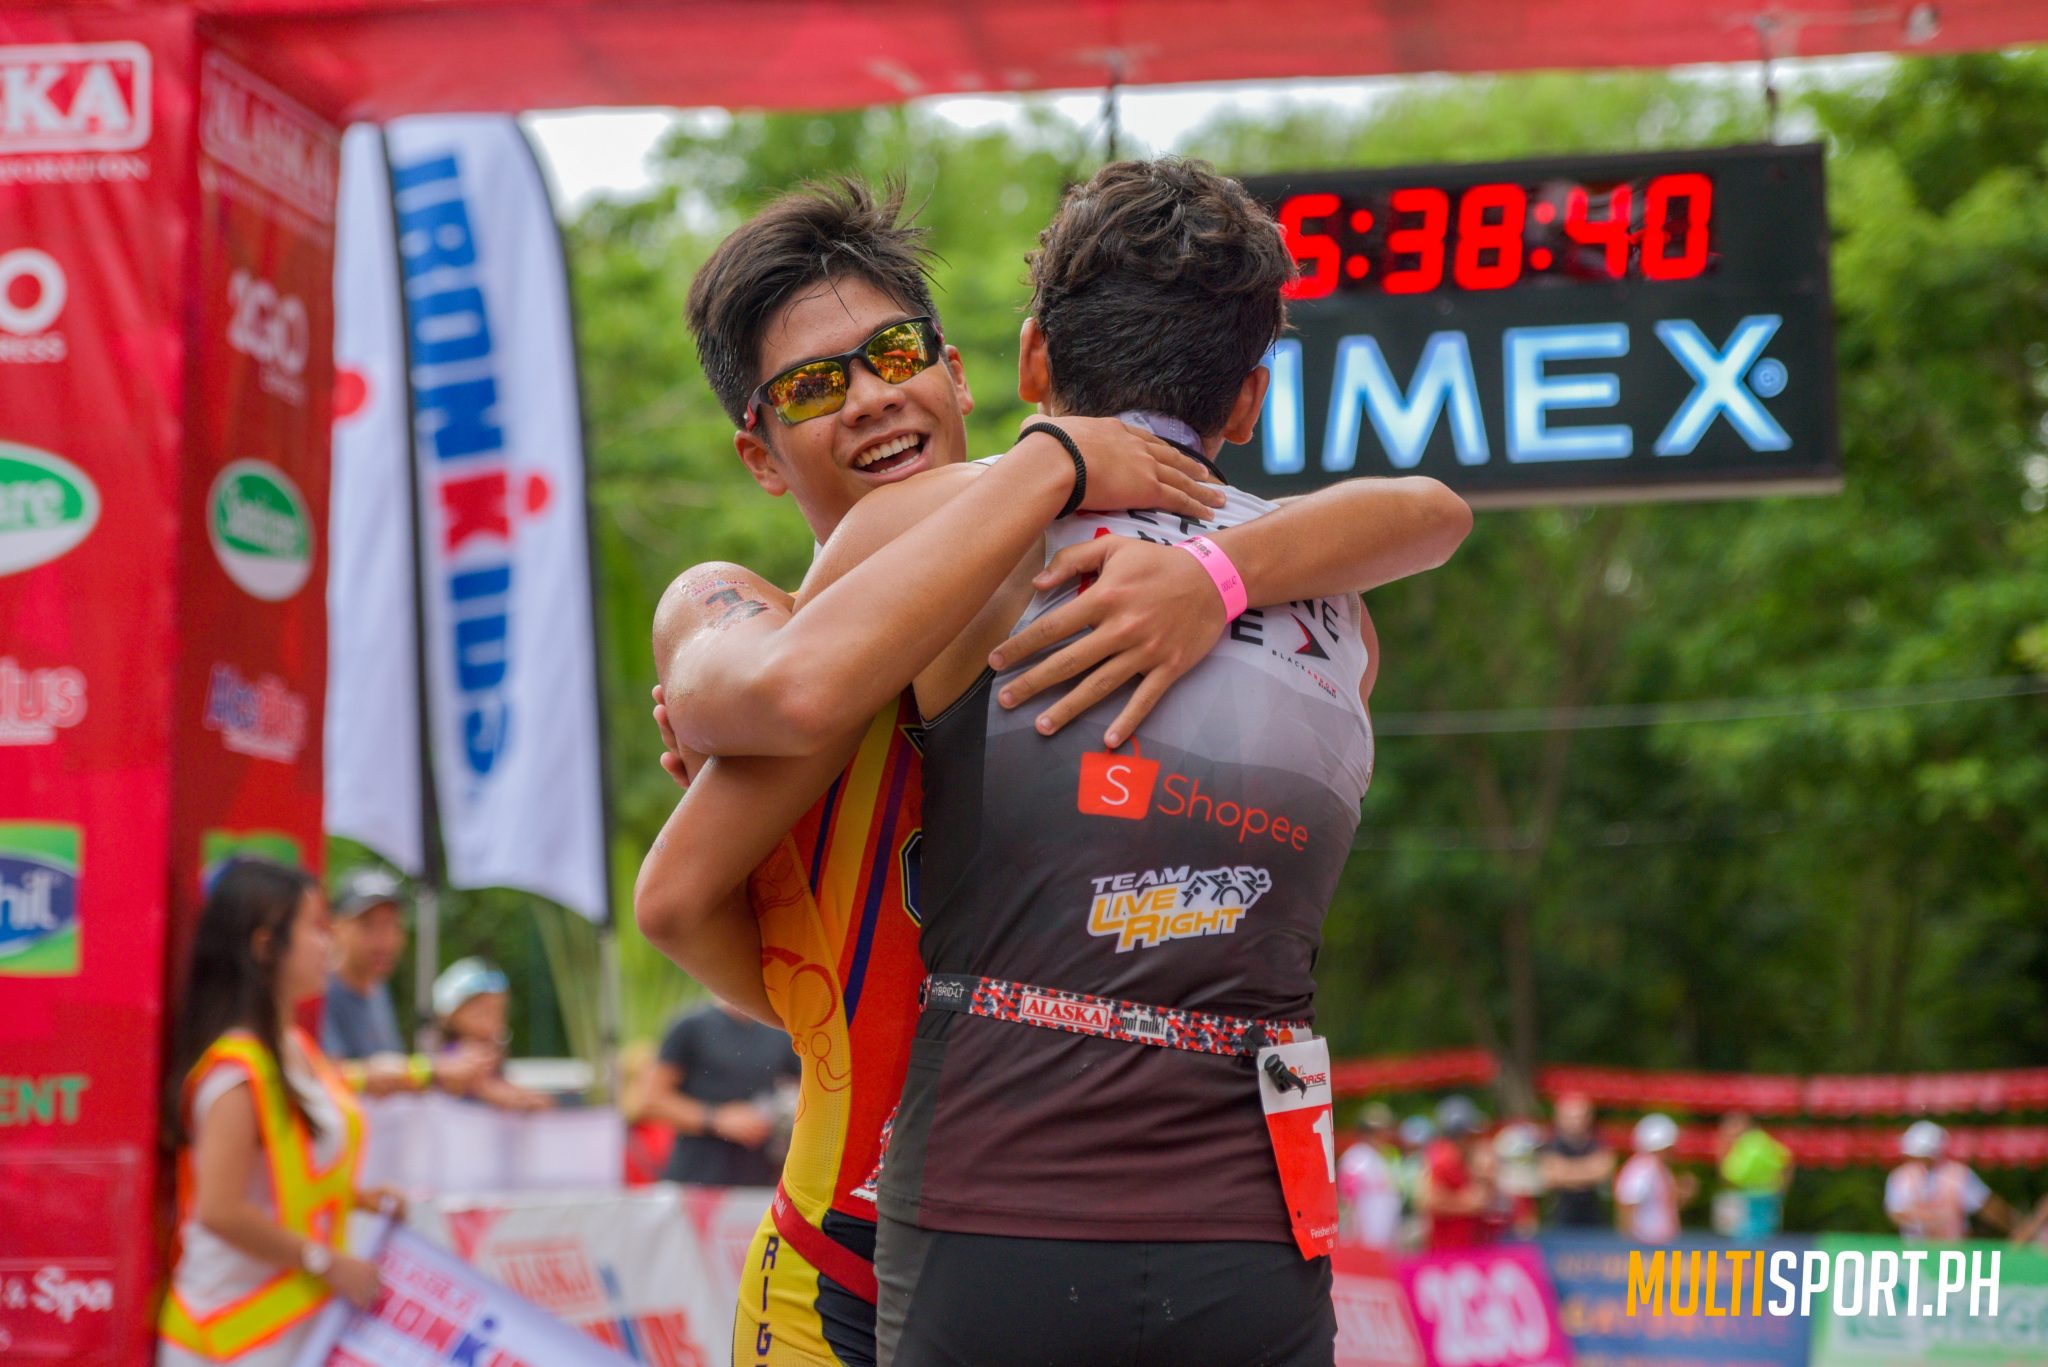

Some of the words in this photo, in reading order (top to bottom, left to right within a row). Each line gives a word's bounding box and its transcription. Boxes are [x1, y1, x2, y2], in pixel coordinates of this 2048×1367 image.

[1157, 773, 1309, 852] Shopee
[1090, 865, 1192, 894] TEAM
[1088, 885, 1180, 936] LIVE
[1116, 905, 1247, 953] RIGHT
[1025, 998, 1104, 1027] ALASKA
[1120, 1014, 1138, 1033] got
[30, 1265, 114, 1325] Spa
